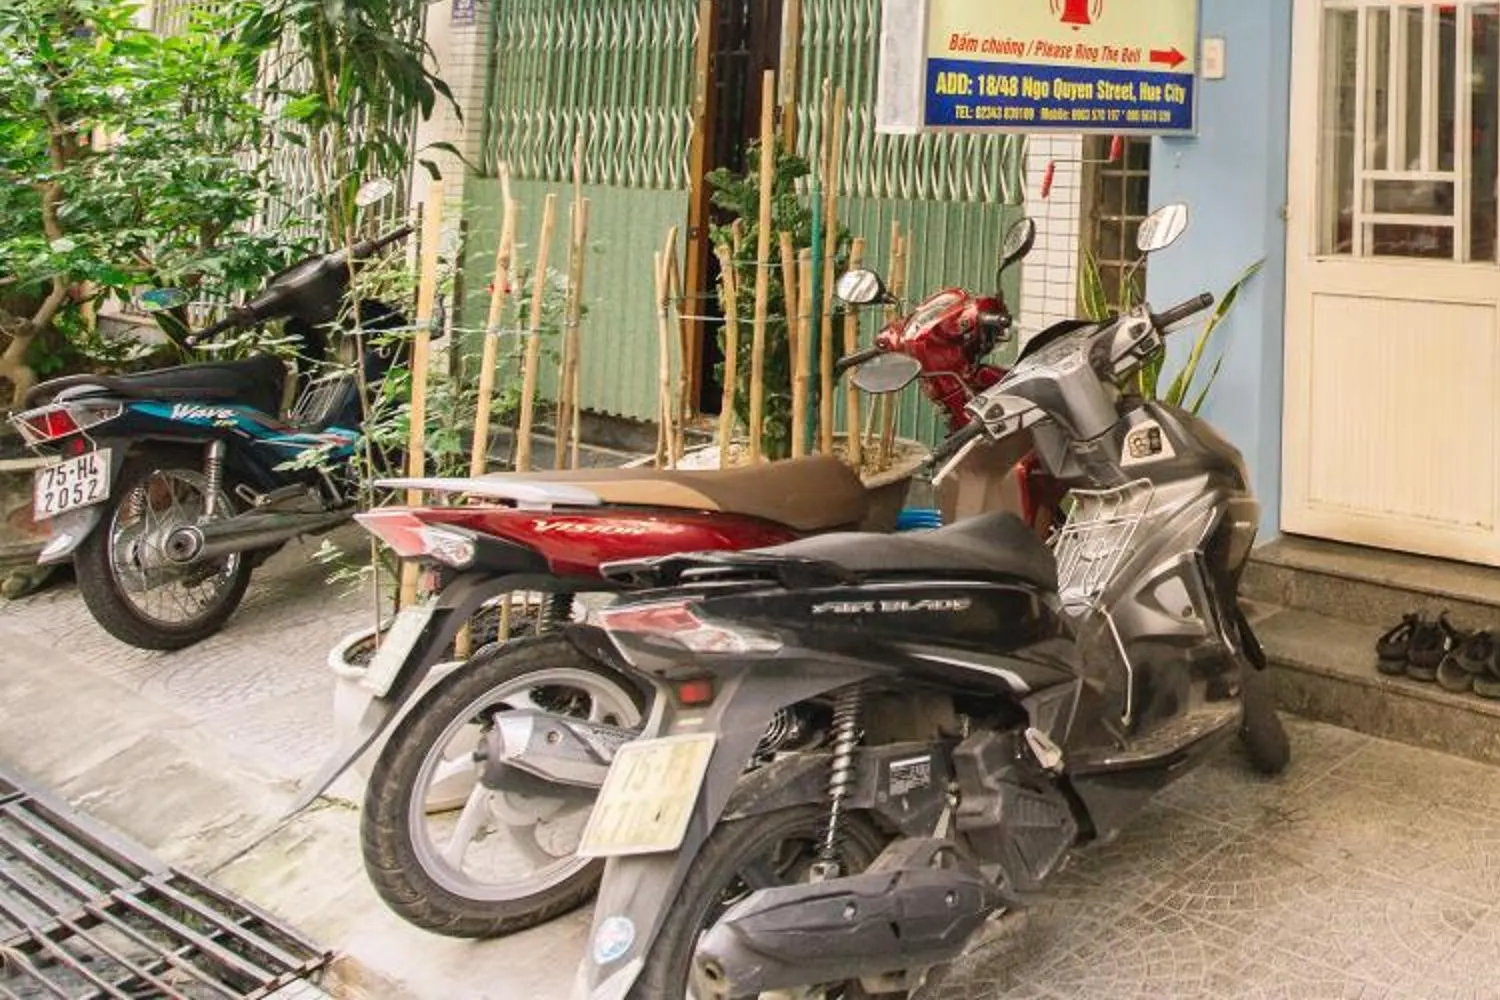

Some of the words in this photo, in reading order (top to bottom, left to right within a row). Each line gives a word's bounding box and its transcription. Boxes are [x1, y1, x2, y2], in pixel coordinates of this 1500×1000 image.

[1035, 40, 1073, 59] Please
[1075, 44, 1099, 62] Ring
[1101, 45, 1119, 61] The
[936, 71, 973, 95] ADD:
[978, 74, 1018, 97] 18/48
[1021, 76, 1049, 101] Ngo
[1053, 78, 1093, 101] Quyen
[1096, 80, 1137, 103] Street,
[1139, 81, 1161, 102] Hue
[1163, 83, 1186, 105] City
[45, 479, 97, 513] 2052
